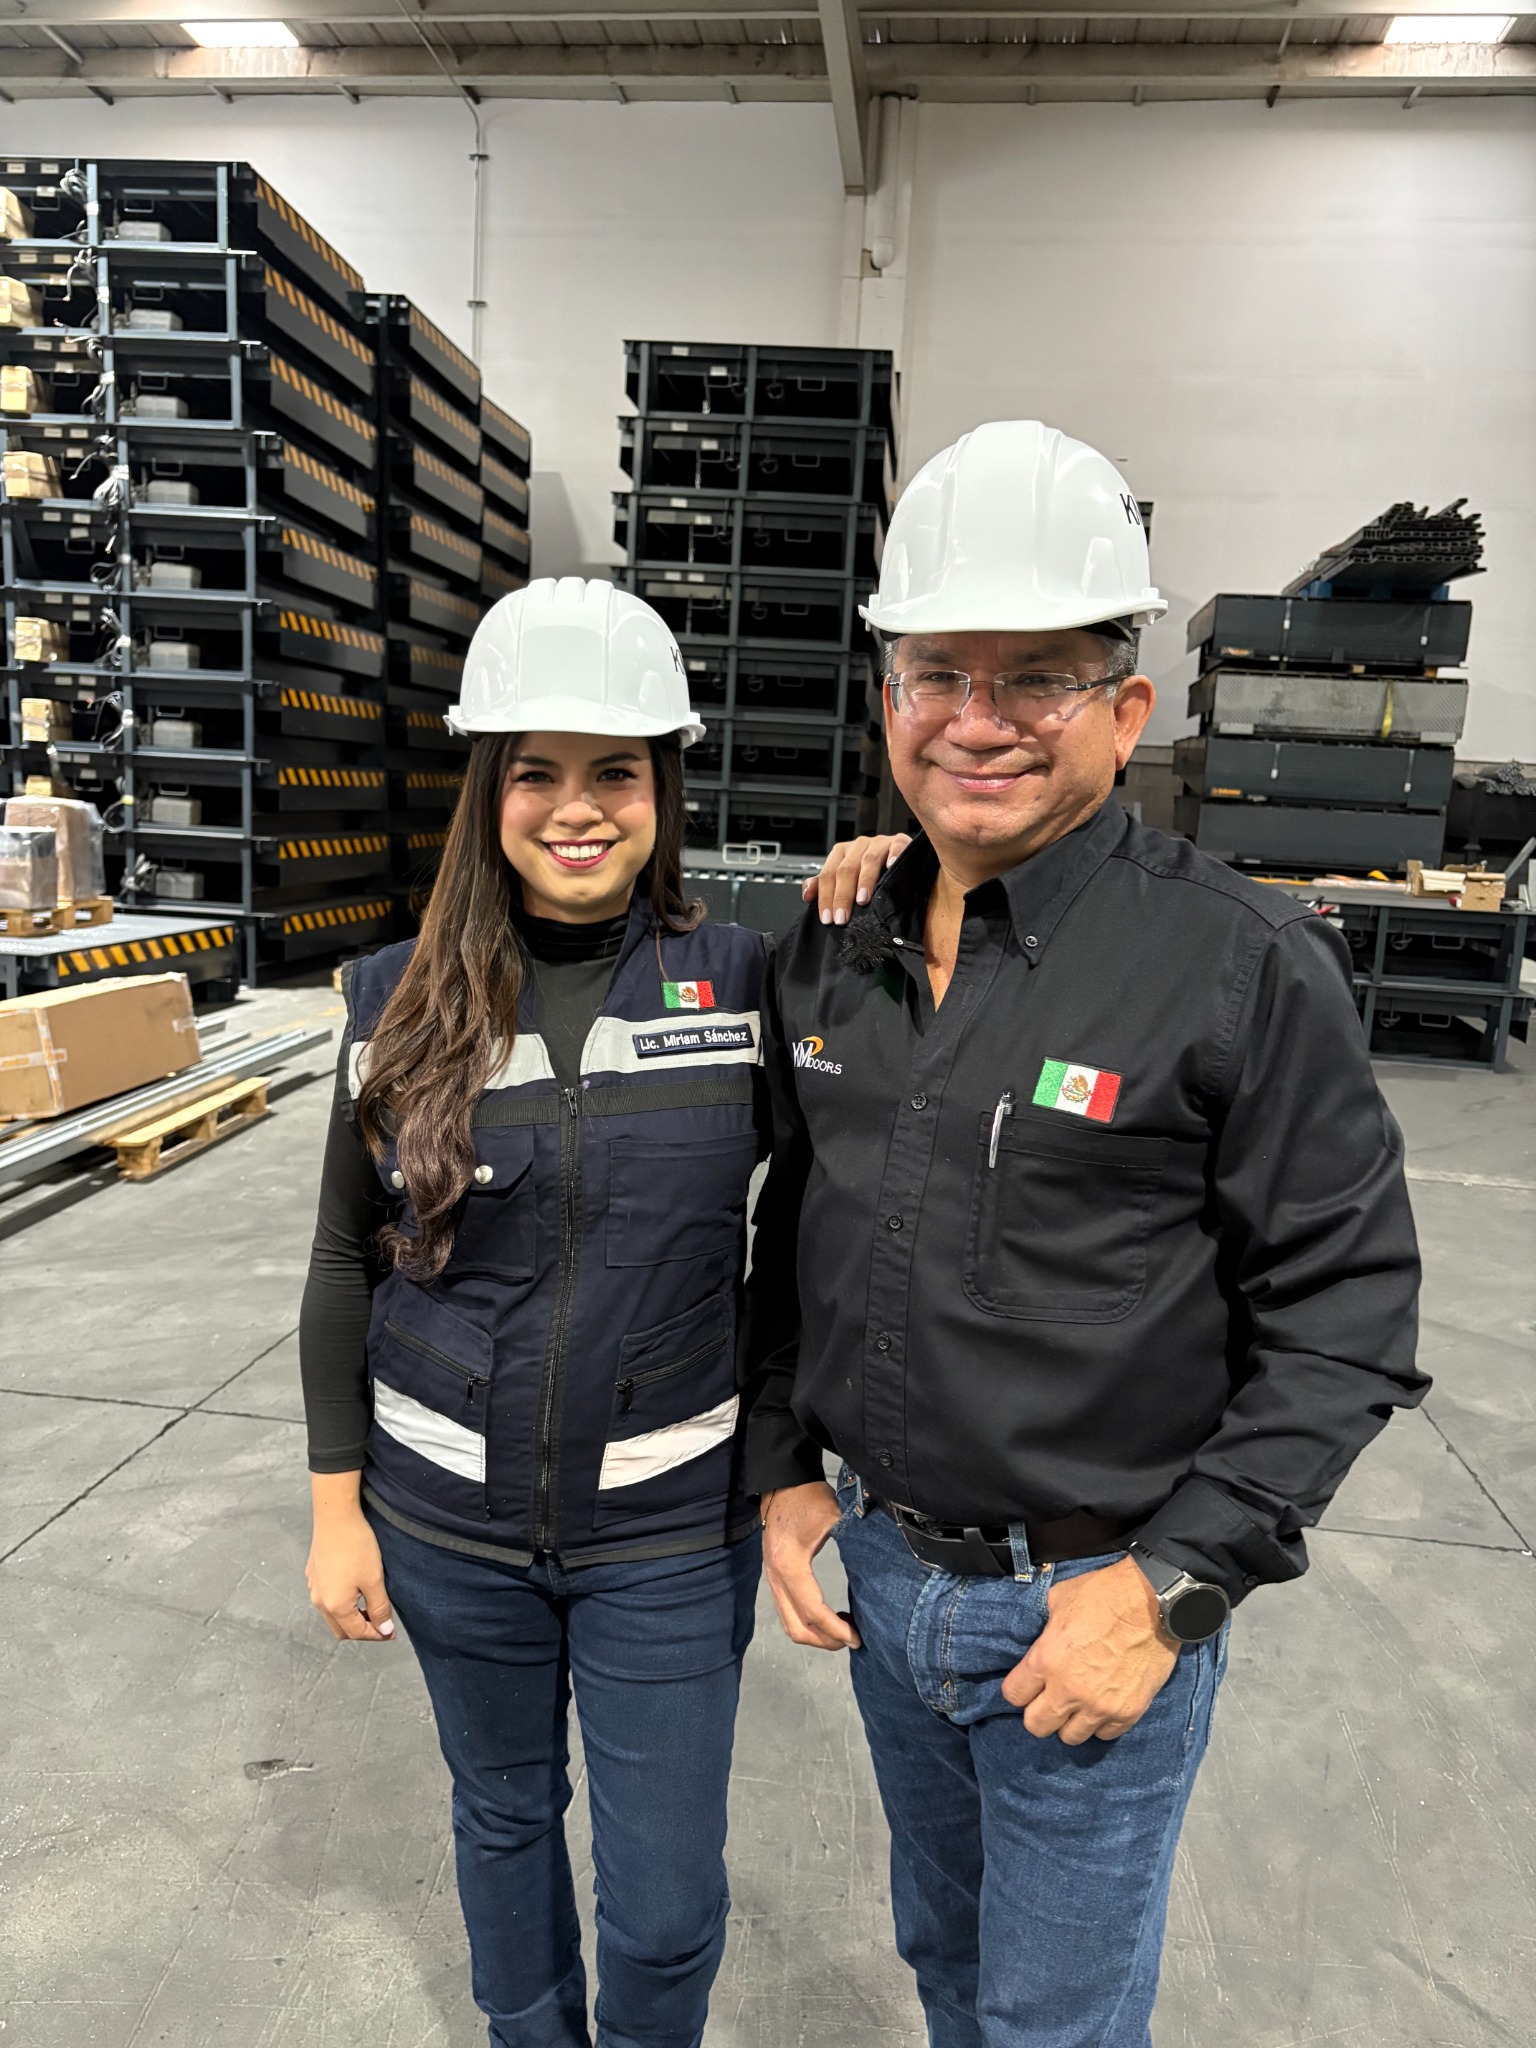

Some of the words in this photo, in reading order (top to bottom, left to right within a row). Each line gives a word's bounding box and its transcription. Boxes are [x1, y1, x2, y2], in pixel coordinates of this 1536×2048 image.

[639, 1038, 660, 1051] Lic.
[663, 1033, 701, 1047] Miriam
[704, 1028, 748, 1043] Sánchez
